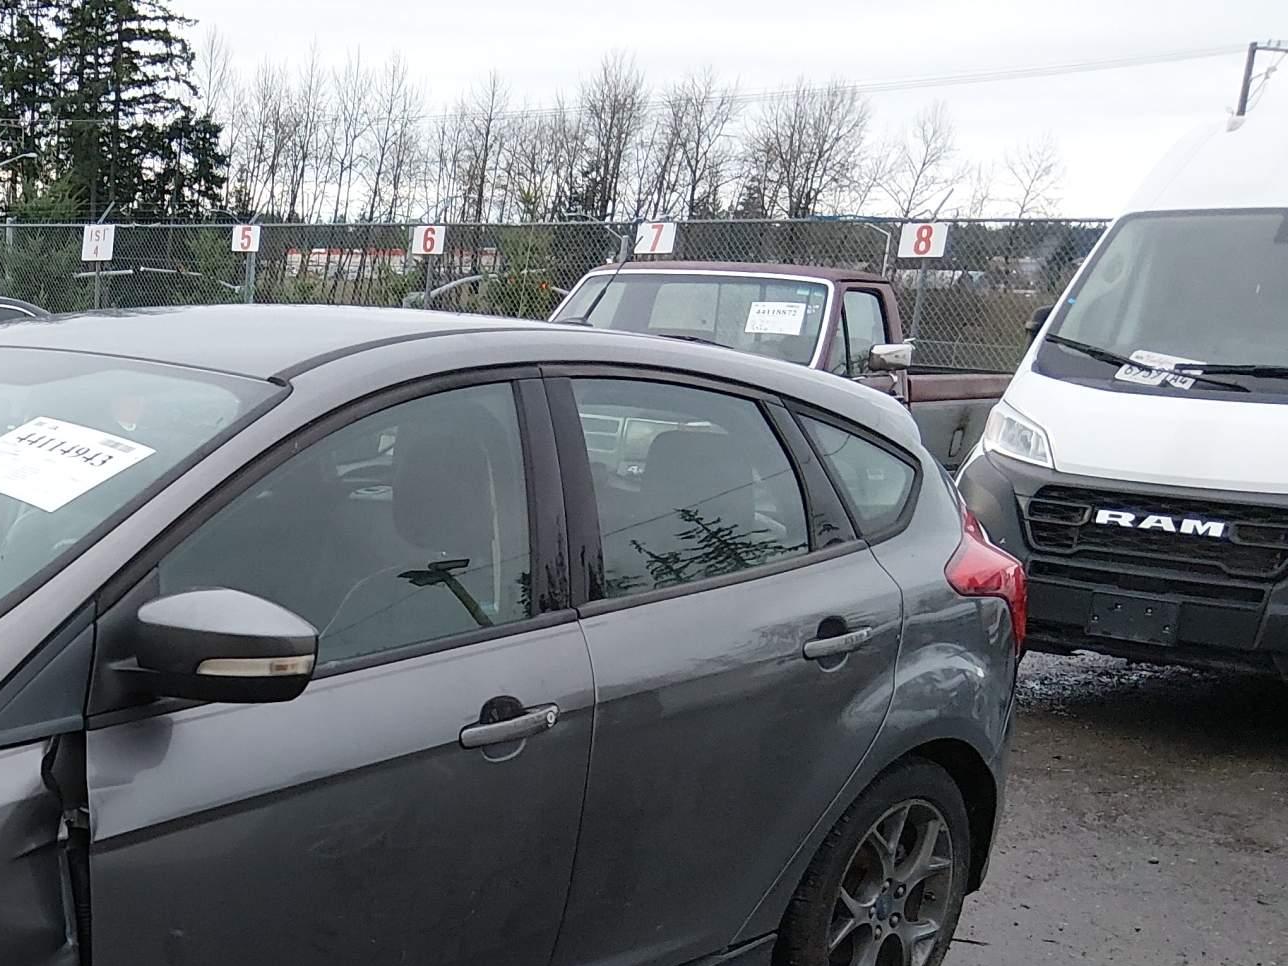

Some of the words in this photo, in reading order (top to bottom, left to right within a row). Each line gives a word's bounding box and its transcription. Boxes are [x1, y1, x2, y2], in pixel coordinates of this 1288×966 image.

[93, 245, 99, 258] 4
[240, 226, 252, 250] 5
[422, 227, 436, 253] 6
[649, 224, 664, 252] 7
[913, 224, 934, 255] 8
[16, 432, 114, 467] 44114943
[1095, 509, 1225, 538] RAM
